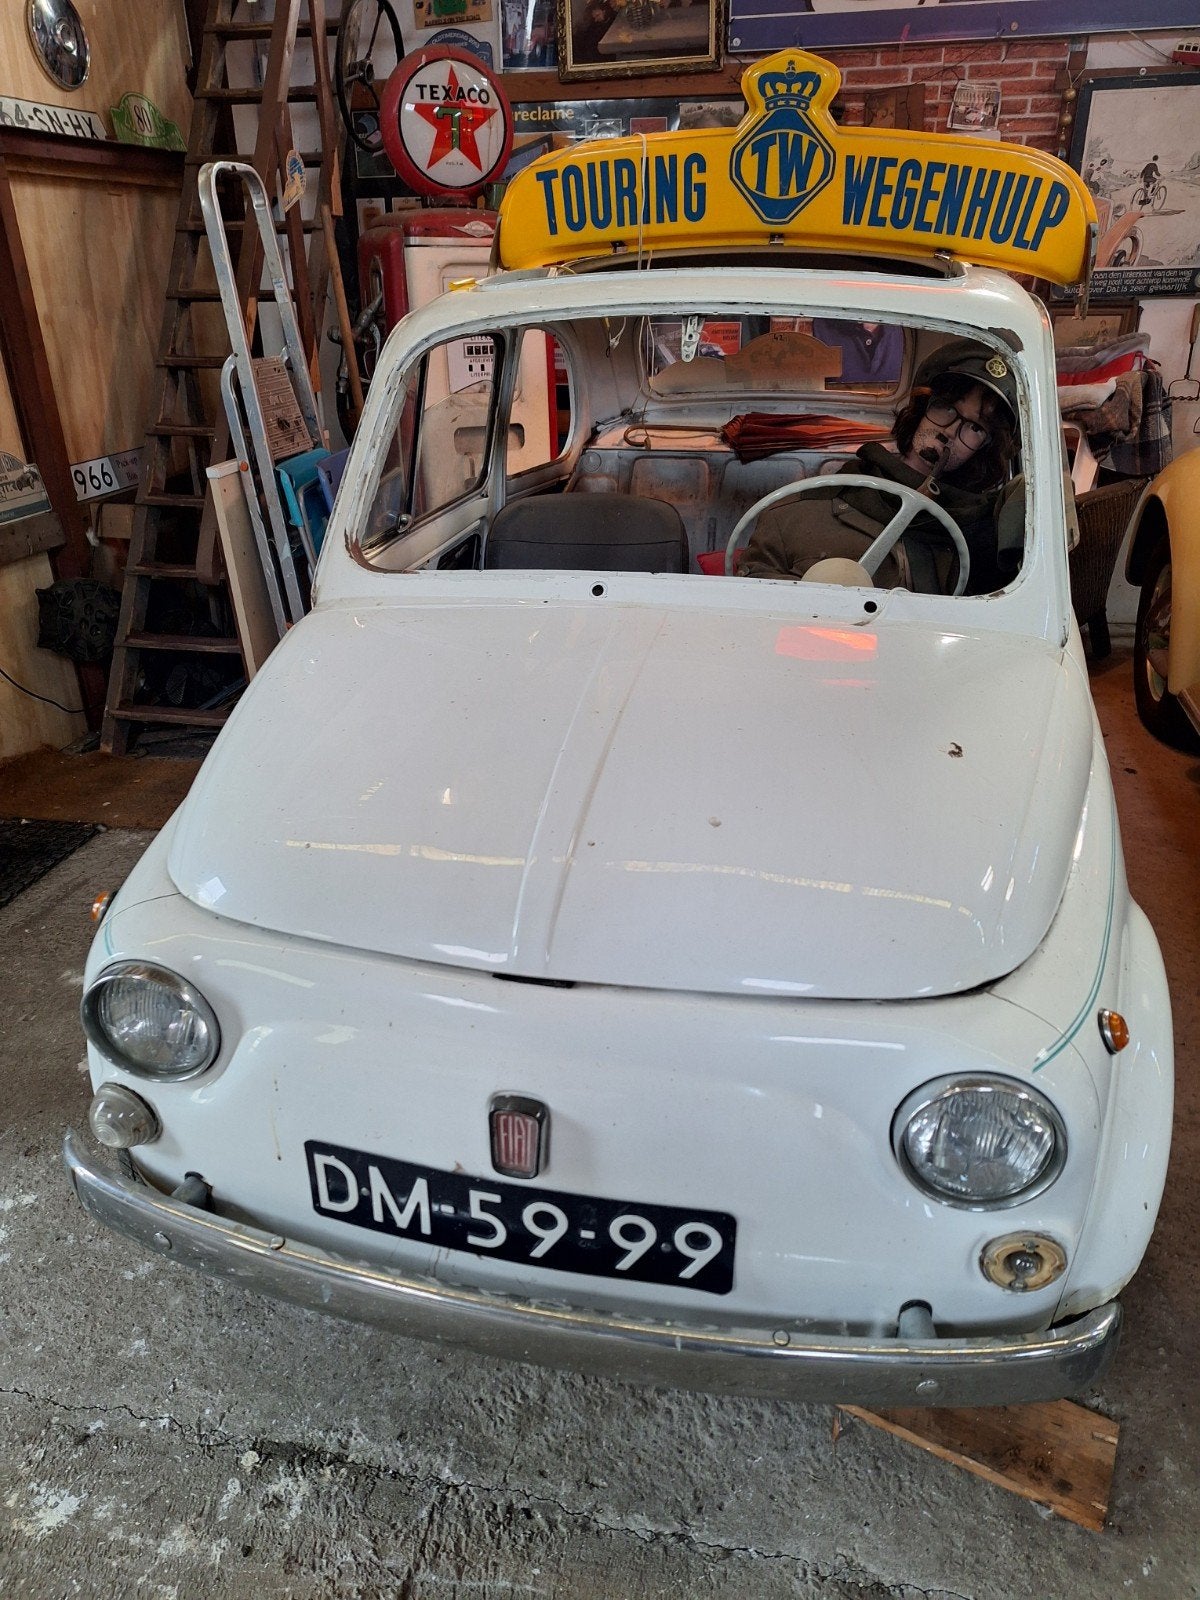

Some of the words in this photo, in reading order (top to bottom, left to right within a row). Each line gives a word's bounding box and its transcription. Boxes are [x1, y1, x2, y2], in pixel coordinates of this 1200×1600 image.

[415, 84, 490, 105] TEXACO
[134, 105, 152, 133] 80
[751, 132, 819, 198] TW
[536, 153, 707, 236] TOURING
[842, 154, 1071, 252] WEGENHULP
[1106, 285, 1119, 293] Dat
[1129, 284, 1147, 292] zeer
[73, 463, 113, 494] 966
[500, 1114, 536, 1169] FIAT
[313, 1153, 724, 1280] DM-59-99
